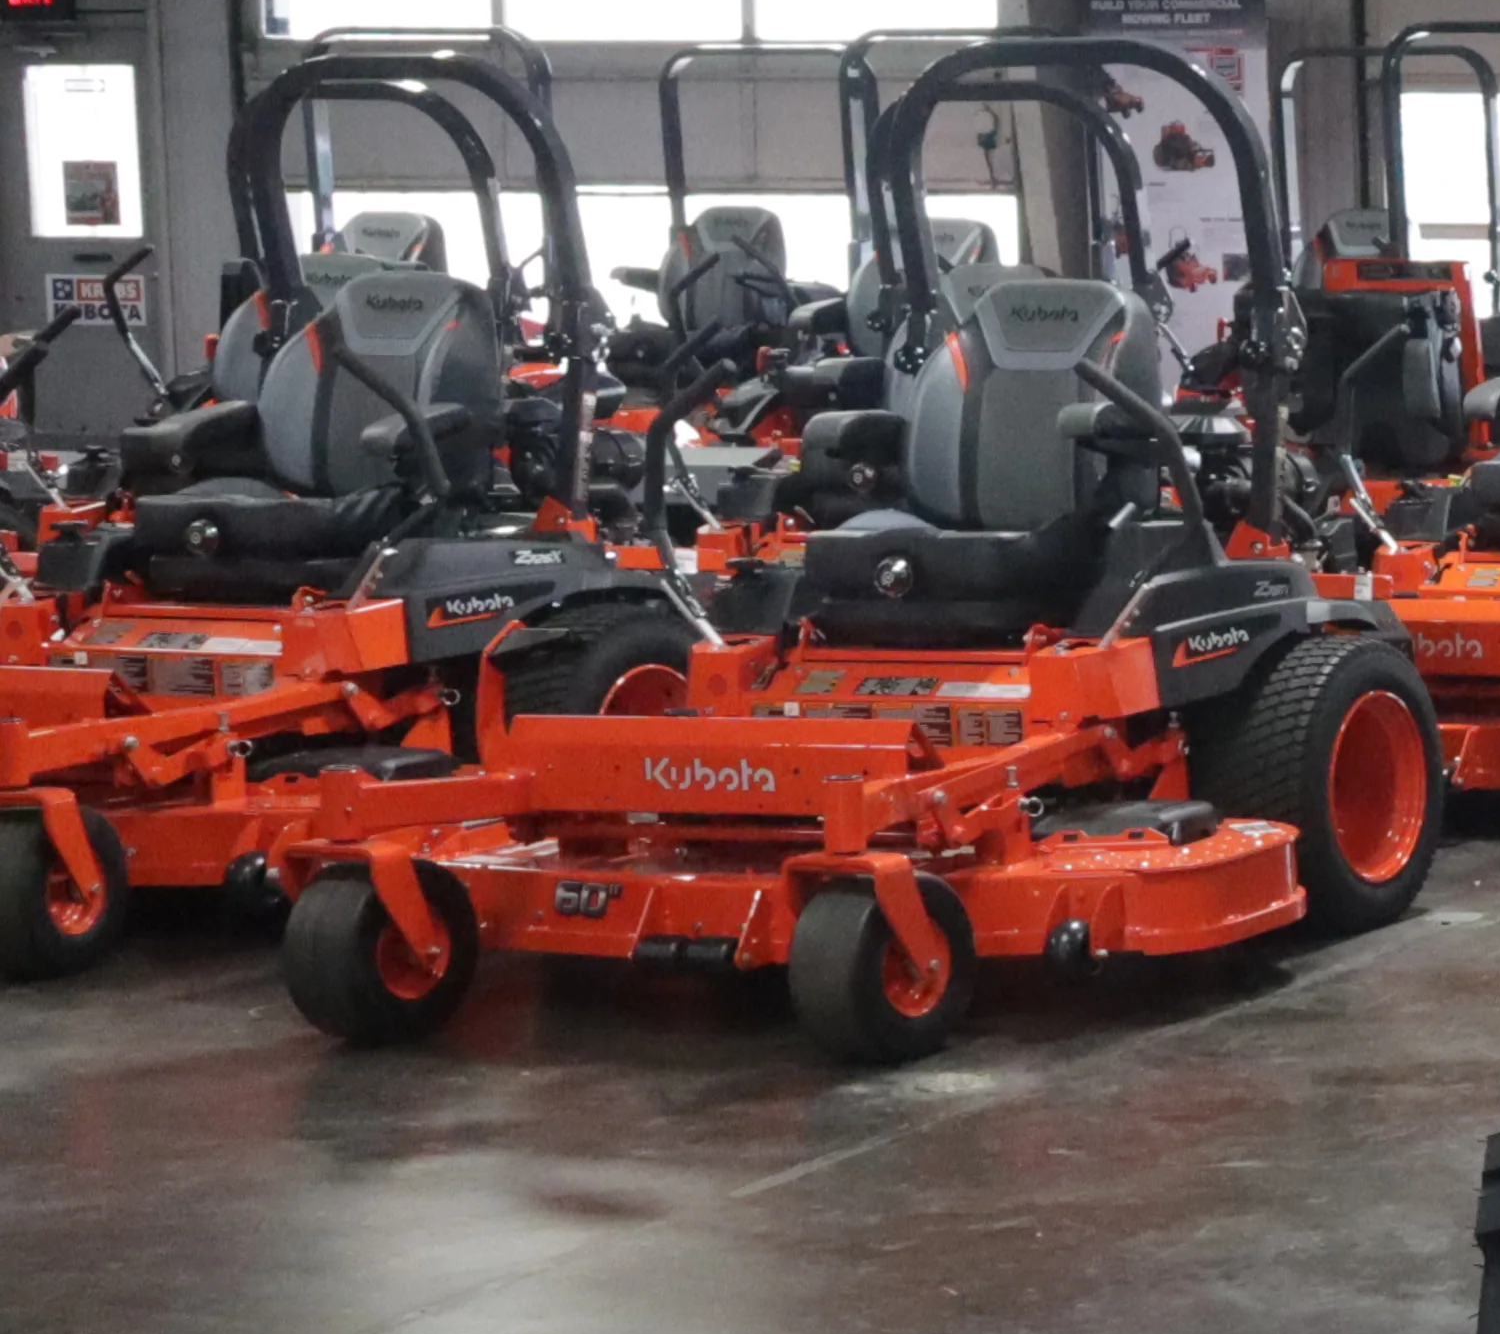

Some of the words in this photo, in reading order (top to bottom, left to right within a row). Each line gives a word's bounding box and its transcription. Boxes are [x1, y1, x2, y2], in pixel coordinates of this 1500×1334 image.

[1091, 0, 1125, 11] BUILD
[1128, 0, 1160, 10] YOUR
[1121, 13, 1171, 24] MOWING
[1174, 12, 1211, 24] FLEET
[366, 294, 424, 310] Kubota
[1010, 305, 1079, 323] Kubota
[446, 593, 515, 615] Kubota
[1188, 627, 1250, 652] Kubota
[1412, 632, 1483, 659] bota
[644, 757, 776, 792] Kubota
